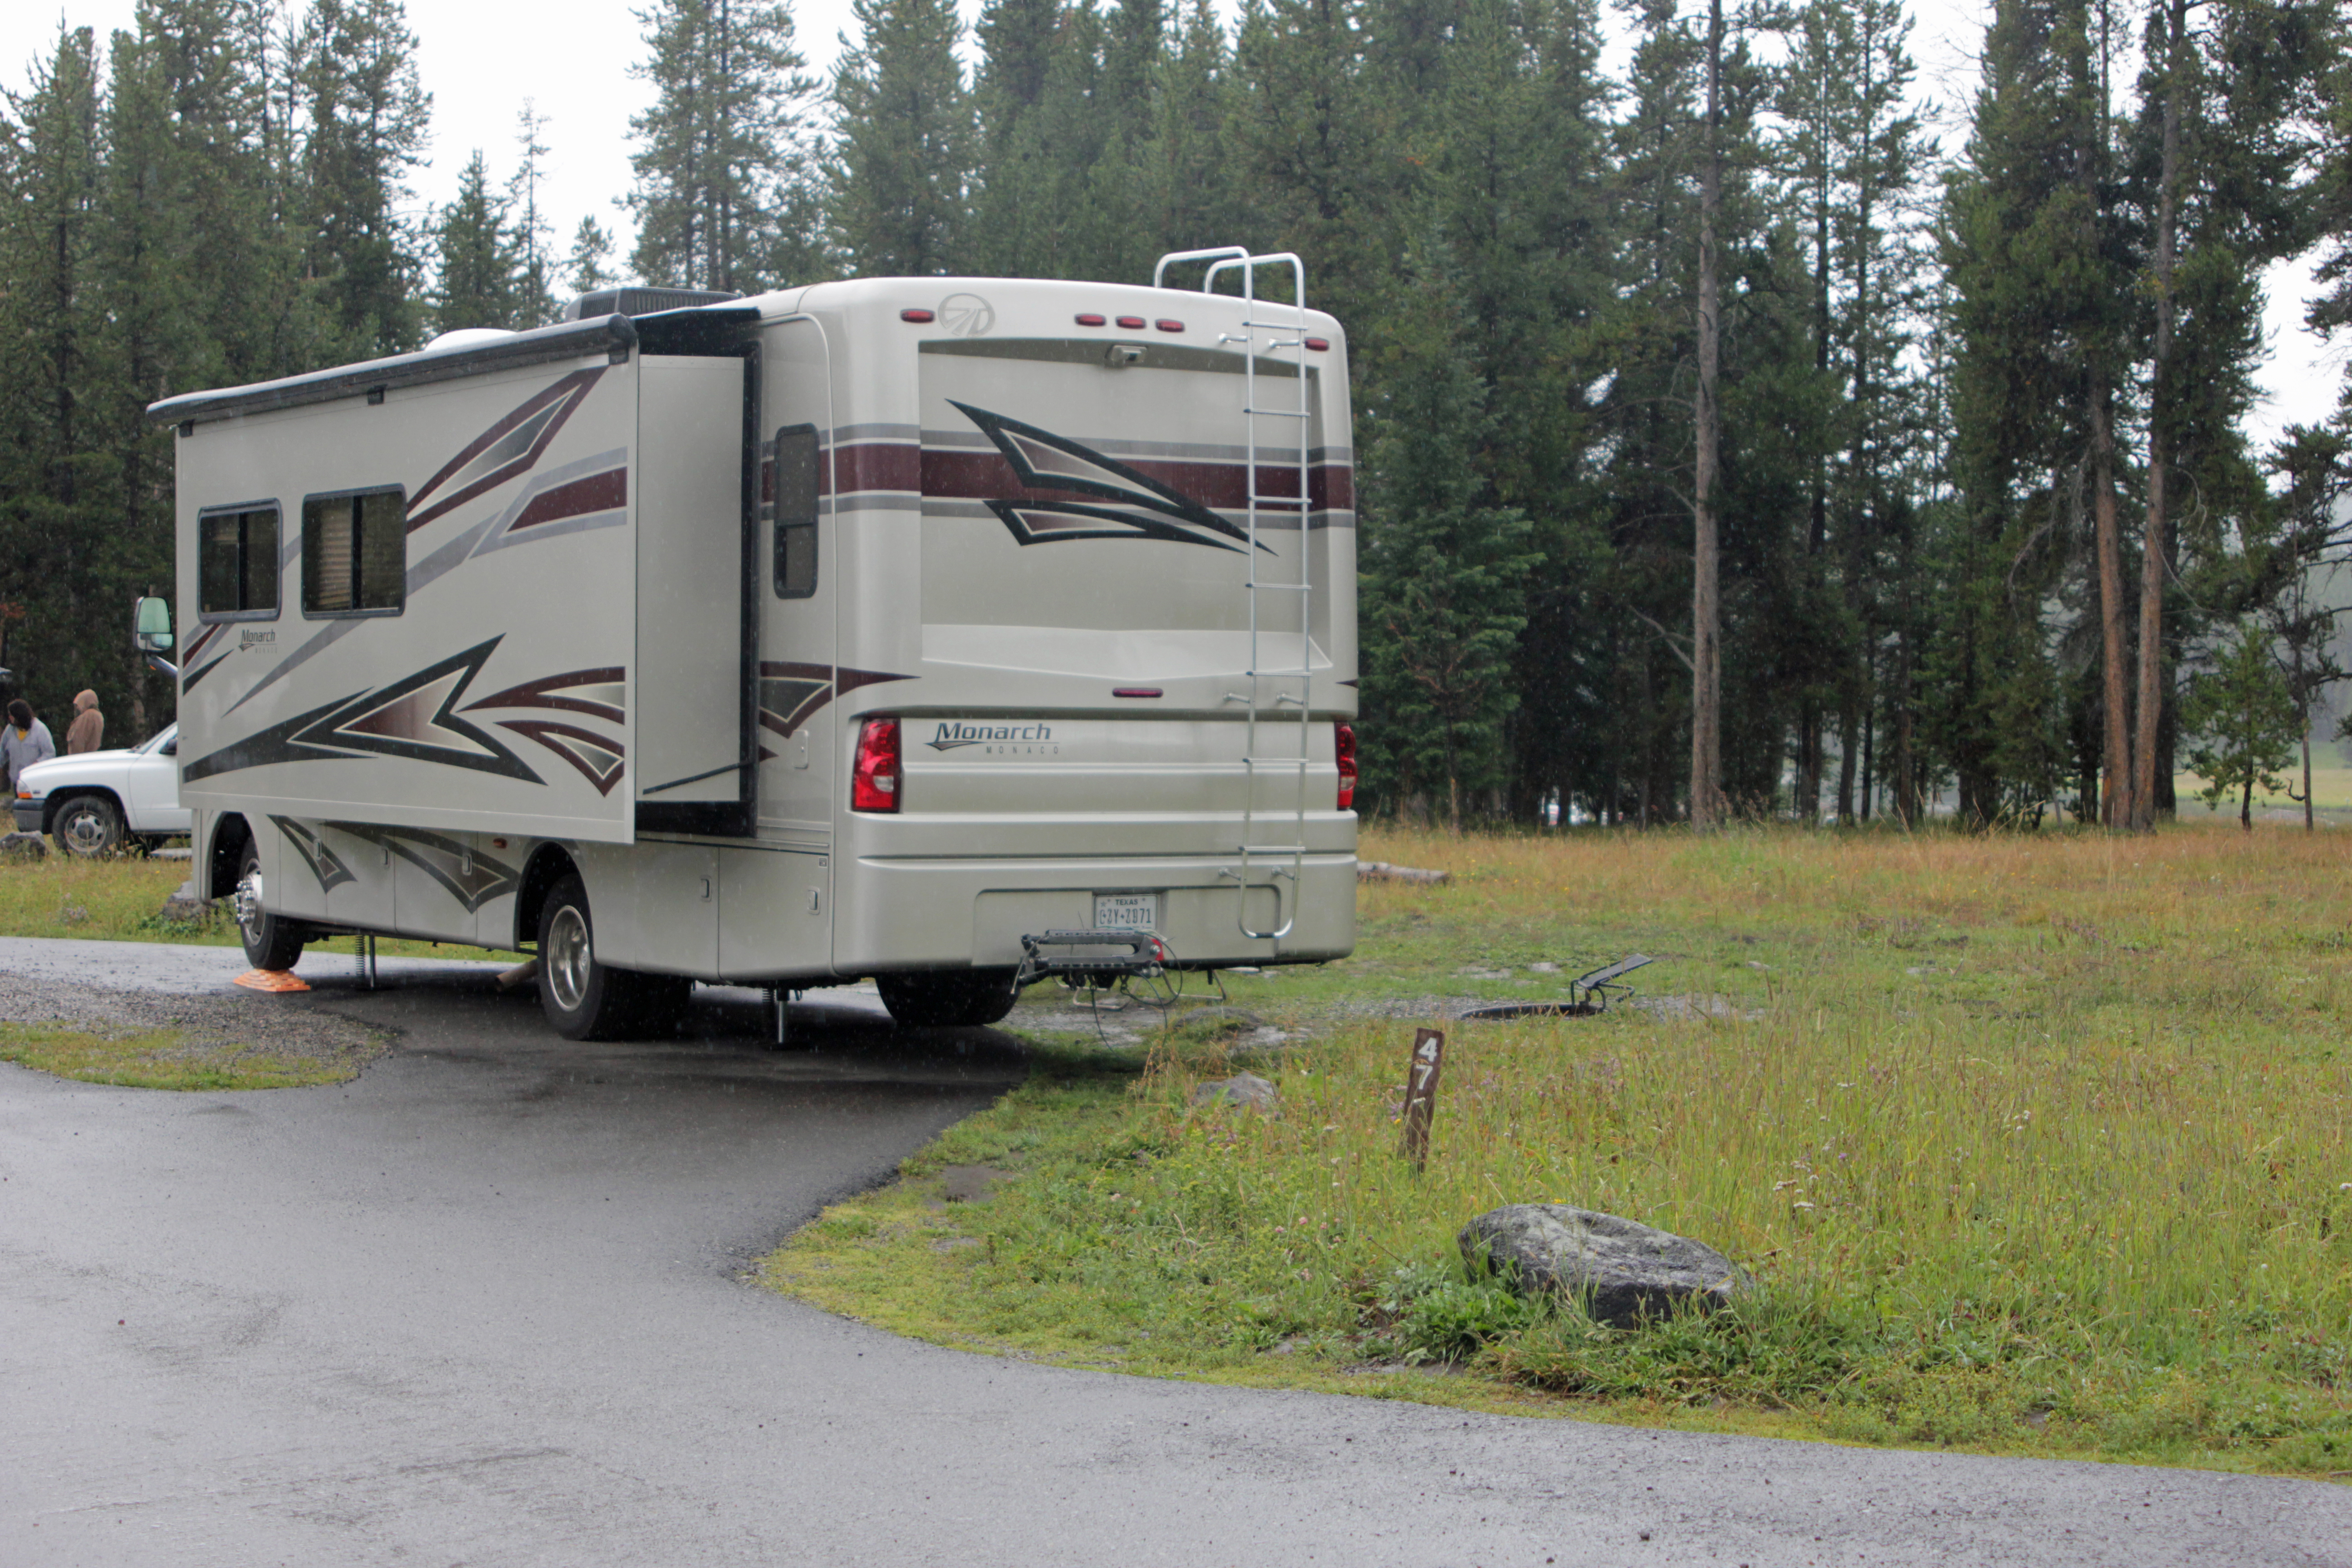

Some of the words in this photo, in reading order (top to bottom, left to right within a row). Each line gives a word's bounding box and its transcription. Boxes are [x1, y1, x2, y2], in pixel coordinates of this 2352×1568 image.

[241, 629, 276, 643] Monarch
[935, 722, 1051, 741] Monarch
[986, 746, 1058, 754] MONACO
[1416, 1037, 1437, 1089] 47
